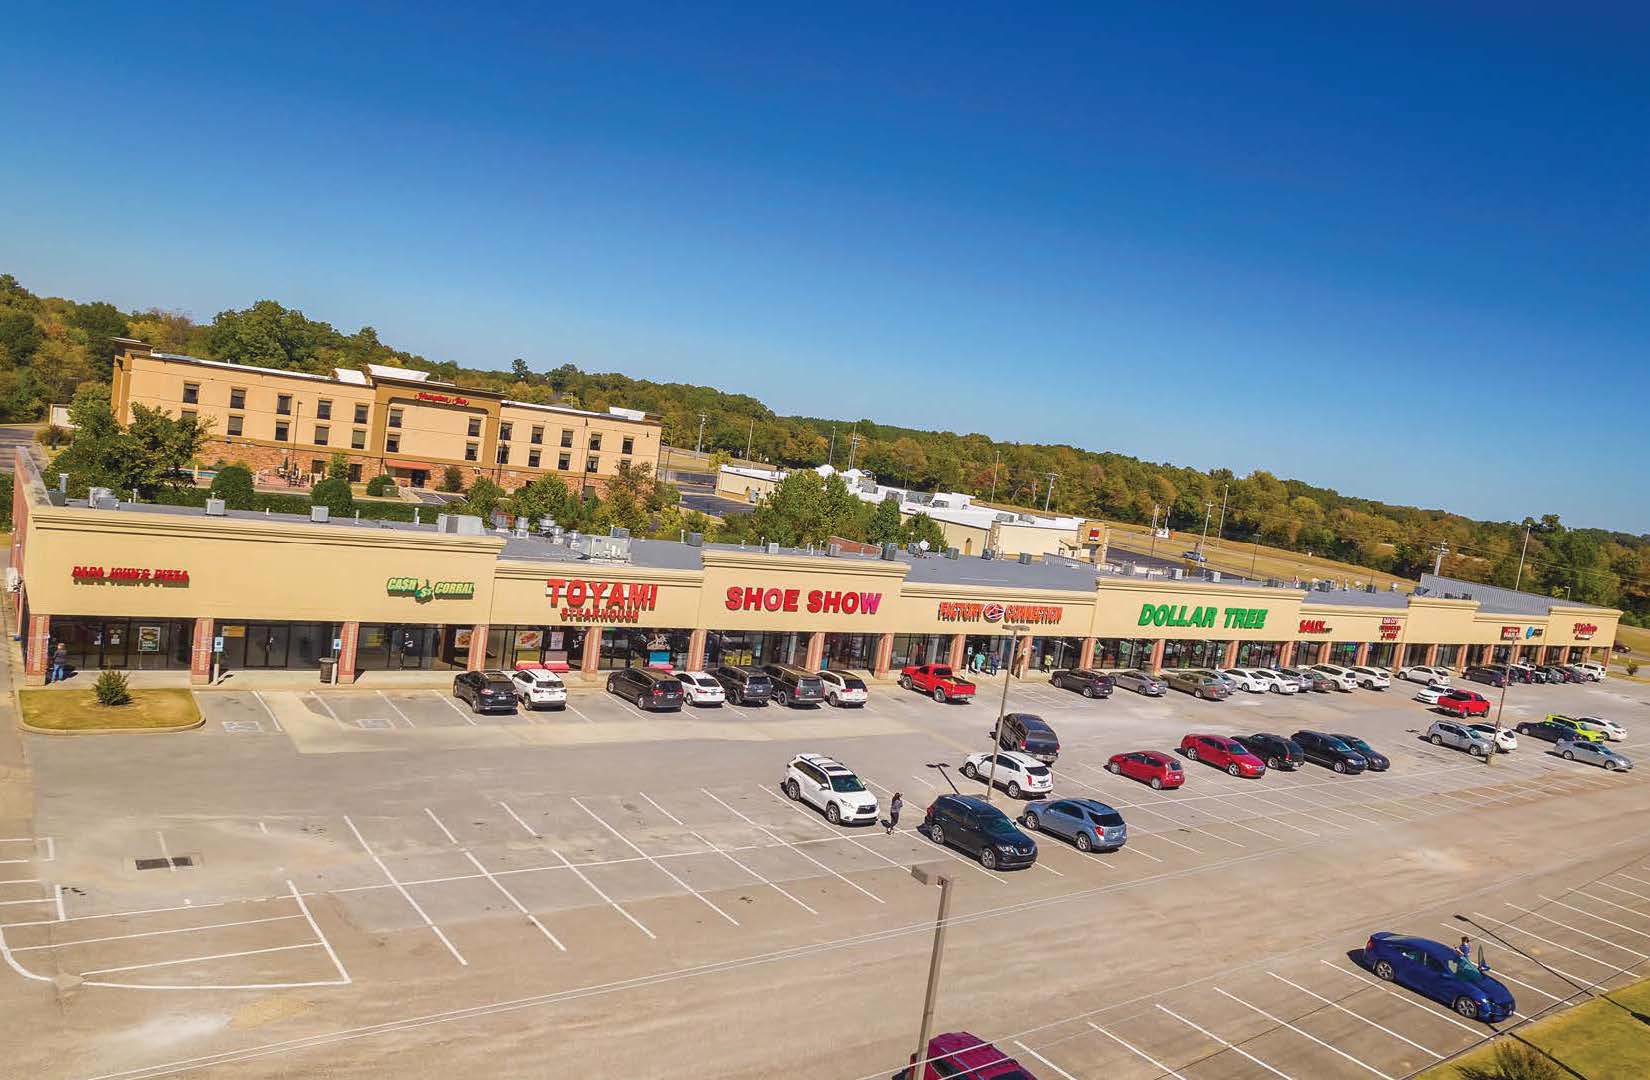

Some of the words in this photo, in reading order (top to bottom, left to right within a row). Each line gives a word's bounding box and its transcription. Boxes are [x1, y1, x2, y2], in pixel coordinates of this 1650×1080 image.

[434, 582, 474, 598] CORRAL
[546, 578, 658, 611] TOYAMI
[725, 586, 800, 612] SHOE
[806, 590, 882, 614] SHOW
[560, 607, 639, 623] STEAKHOUSE
[938, 601, 983, 622] FACTORY
[1137, 603, 1218, 628] DOLLAR
[1223, 607, 1269, 629] TREE
